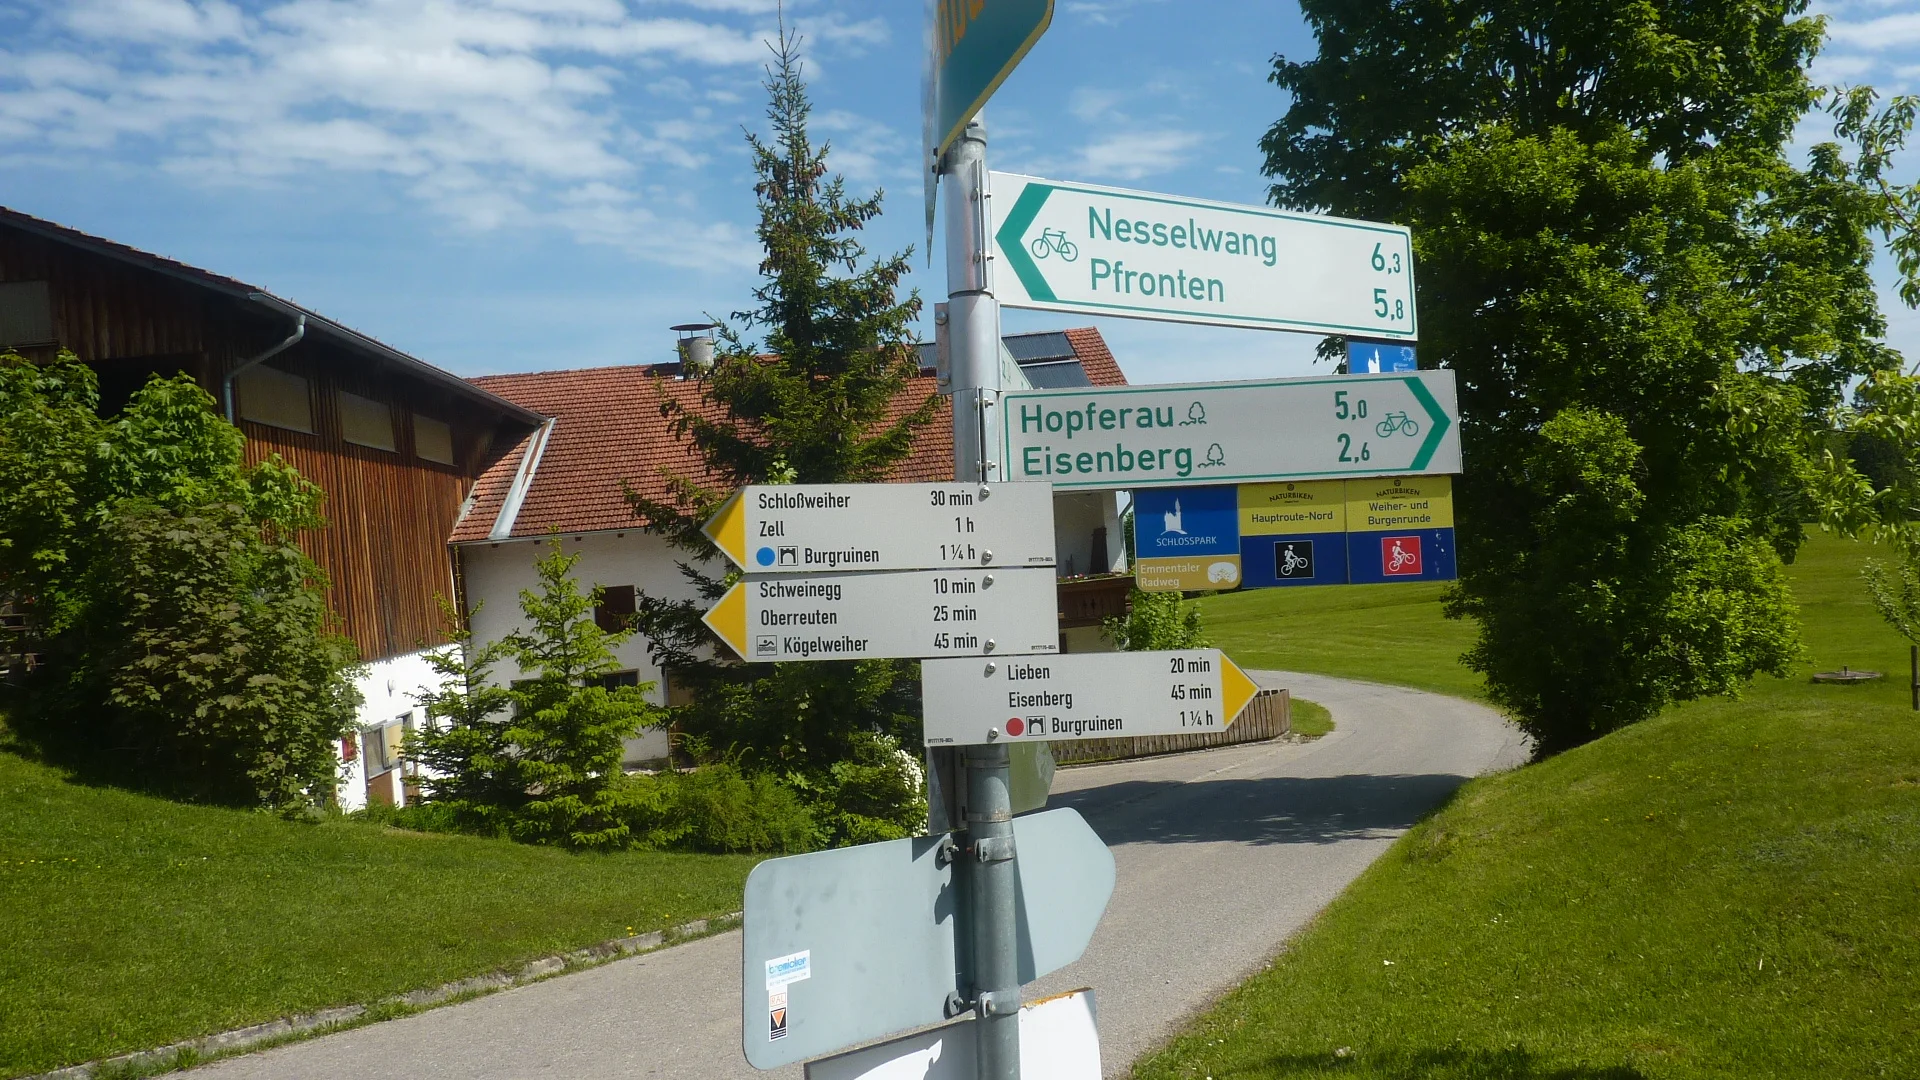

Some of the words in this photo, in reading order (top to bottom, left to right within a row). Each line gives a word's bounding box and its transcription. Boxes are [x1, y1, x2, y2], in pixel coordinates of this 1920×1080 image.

[1088, 206, 1277, 267] Nesselwang
[1371, 242, 1401, 275] 6,3
[1090, 257, 1225, 303] Pfronten
[1374, 288, 1404, 321] 5,8
[1335, 390, 1367, 421] 5,0
[1021, 401, 1174, 437] Hopferau
[1338, 433, 1370, 463] 2,6
[1023, 444, 1193, 477] Eisenberg
[930, 491, 946, 506] 30
[949, 490, 974, 506] min
[1269, 492, 1314, 502] NATURBIKEN
[1376, 487, 1420, 497] NATURBIKEN
[758, 493, 851, 510] Schloßweiher
[1368, 501, 1407, 512] Weiher-
[1409, 500, 1428, 511] und
[955, 518, 961, 533] 1
[966, 517, 975, 532] h
[1251, 511, 1334, 524] Hauptroute-Nord
[1367, 513, 1431, 526] Burgenrunde
[759, 521, 785, 537] Zell
[1156, 536, 1217, 547] SCHLOSSPARK
[804, 547, 880, 567] Burgruinen
[940, 545, 946, 560] 1
[967, 544, 976, 560] h
[1140, 562, 1200, 574] Emmentaler
[933, 579, 948, 594] 10
[952, 578, 976, 594] min
[1141, 576, 1180, 589] Radweg
[759, 582, 842, 600] Schweinegg
[760, 610, 837, 626] Oberreuten
[933, 607, 949, 622] 25
[953, 605, 977, 621] min
[783, 636, 869, 657] Kögelweiher
[934, 634, 950, 649] 45
[953, 633, 978, 648] min
[1007, 664, 1050, 681] Lieben
[1170, 658, 1185, 673] 20
[1188, 657, 1210, 673] min
[1171, 685, 1186, 700] 45
[1189, 684, 1212, 700] min
[1009, 692, 1073, 710] Eisenberg
[1179, 711, 1185, 726] 1
[1205, 711, 1213, 726] h
[1052, 717, 1123, 737] Burgruinen
